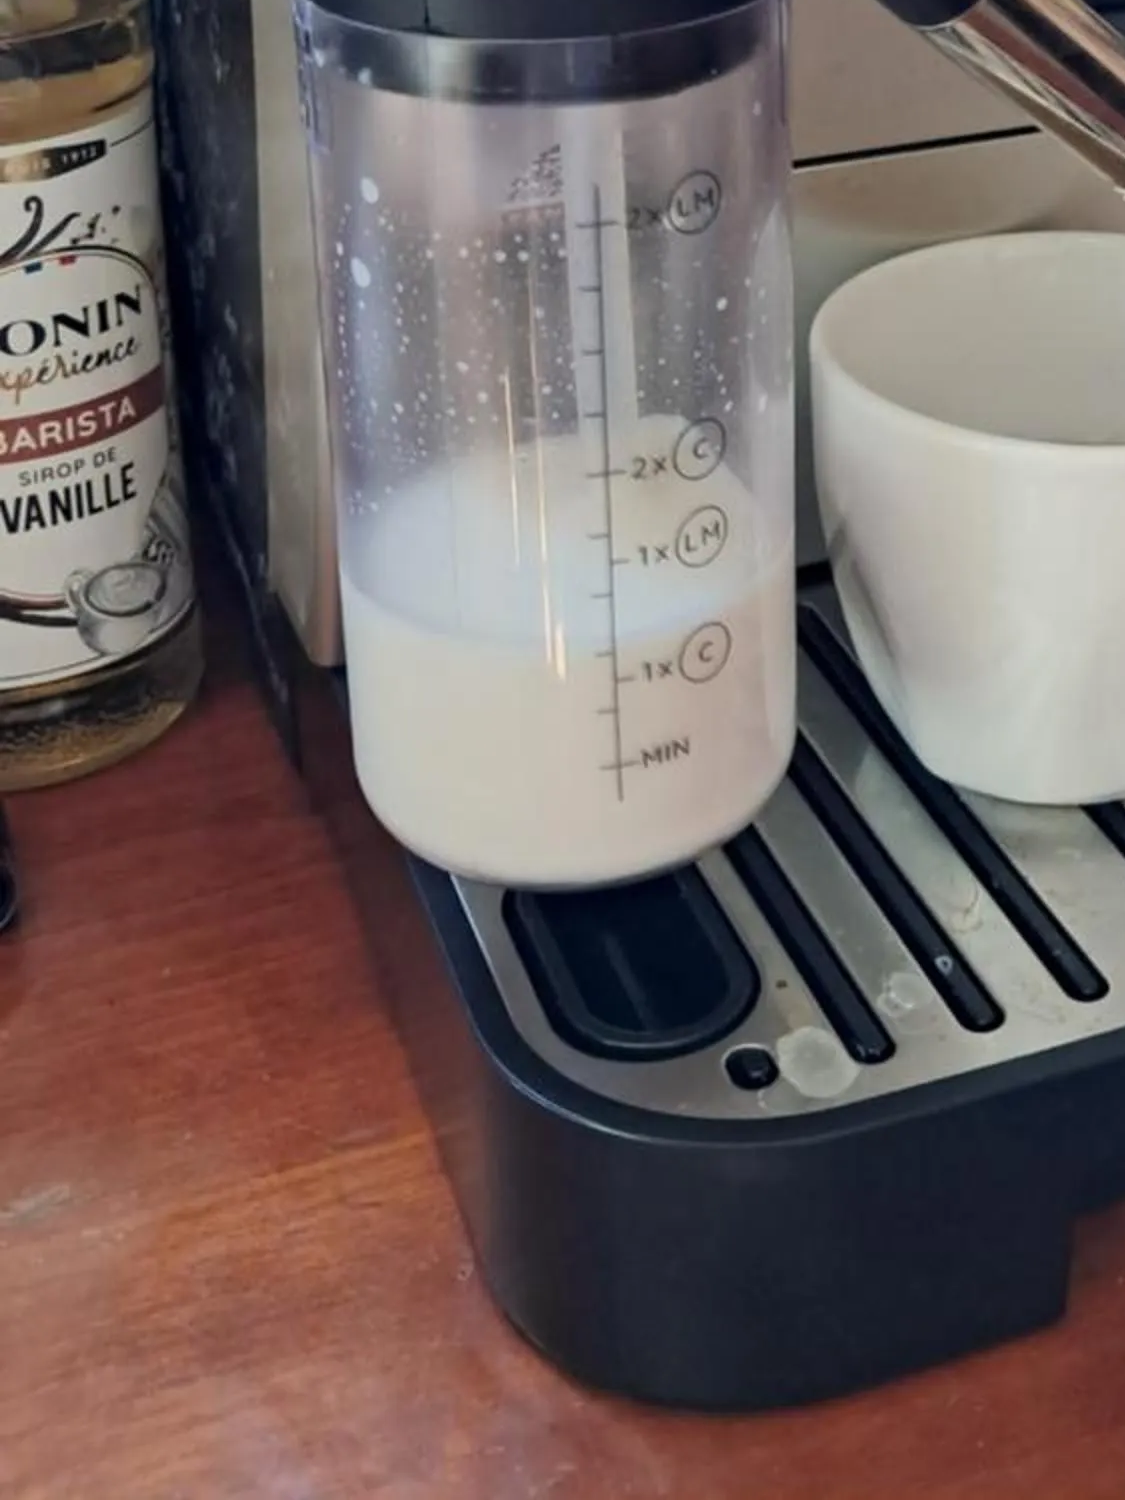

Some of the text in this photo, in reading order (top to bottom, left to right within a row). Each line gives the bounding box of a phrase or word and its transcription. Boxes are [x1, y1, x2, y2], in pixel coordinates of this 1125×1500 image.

[0, 284, 142, 357] ONIN
[0, 336, 139, 406] xpérience
[18, 445, 117, 487] SIROP DE
[632, 456, 667, 480] 2x
[0, 461, 138, 535] VANILLE
[638, 520, 721, 566] 1x LM
[642, 661, 673, 683] 1x
[641, 736, 691, 769] MIN
